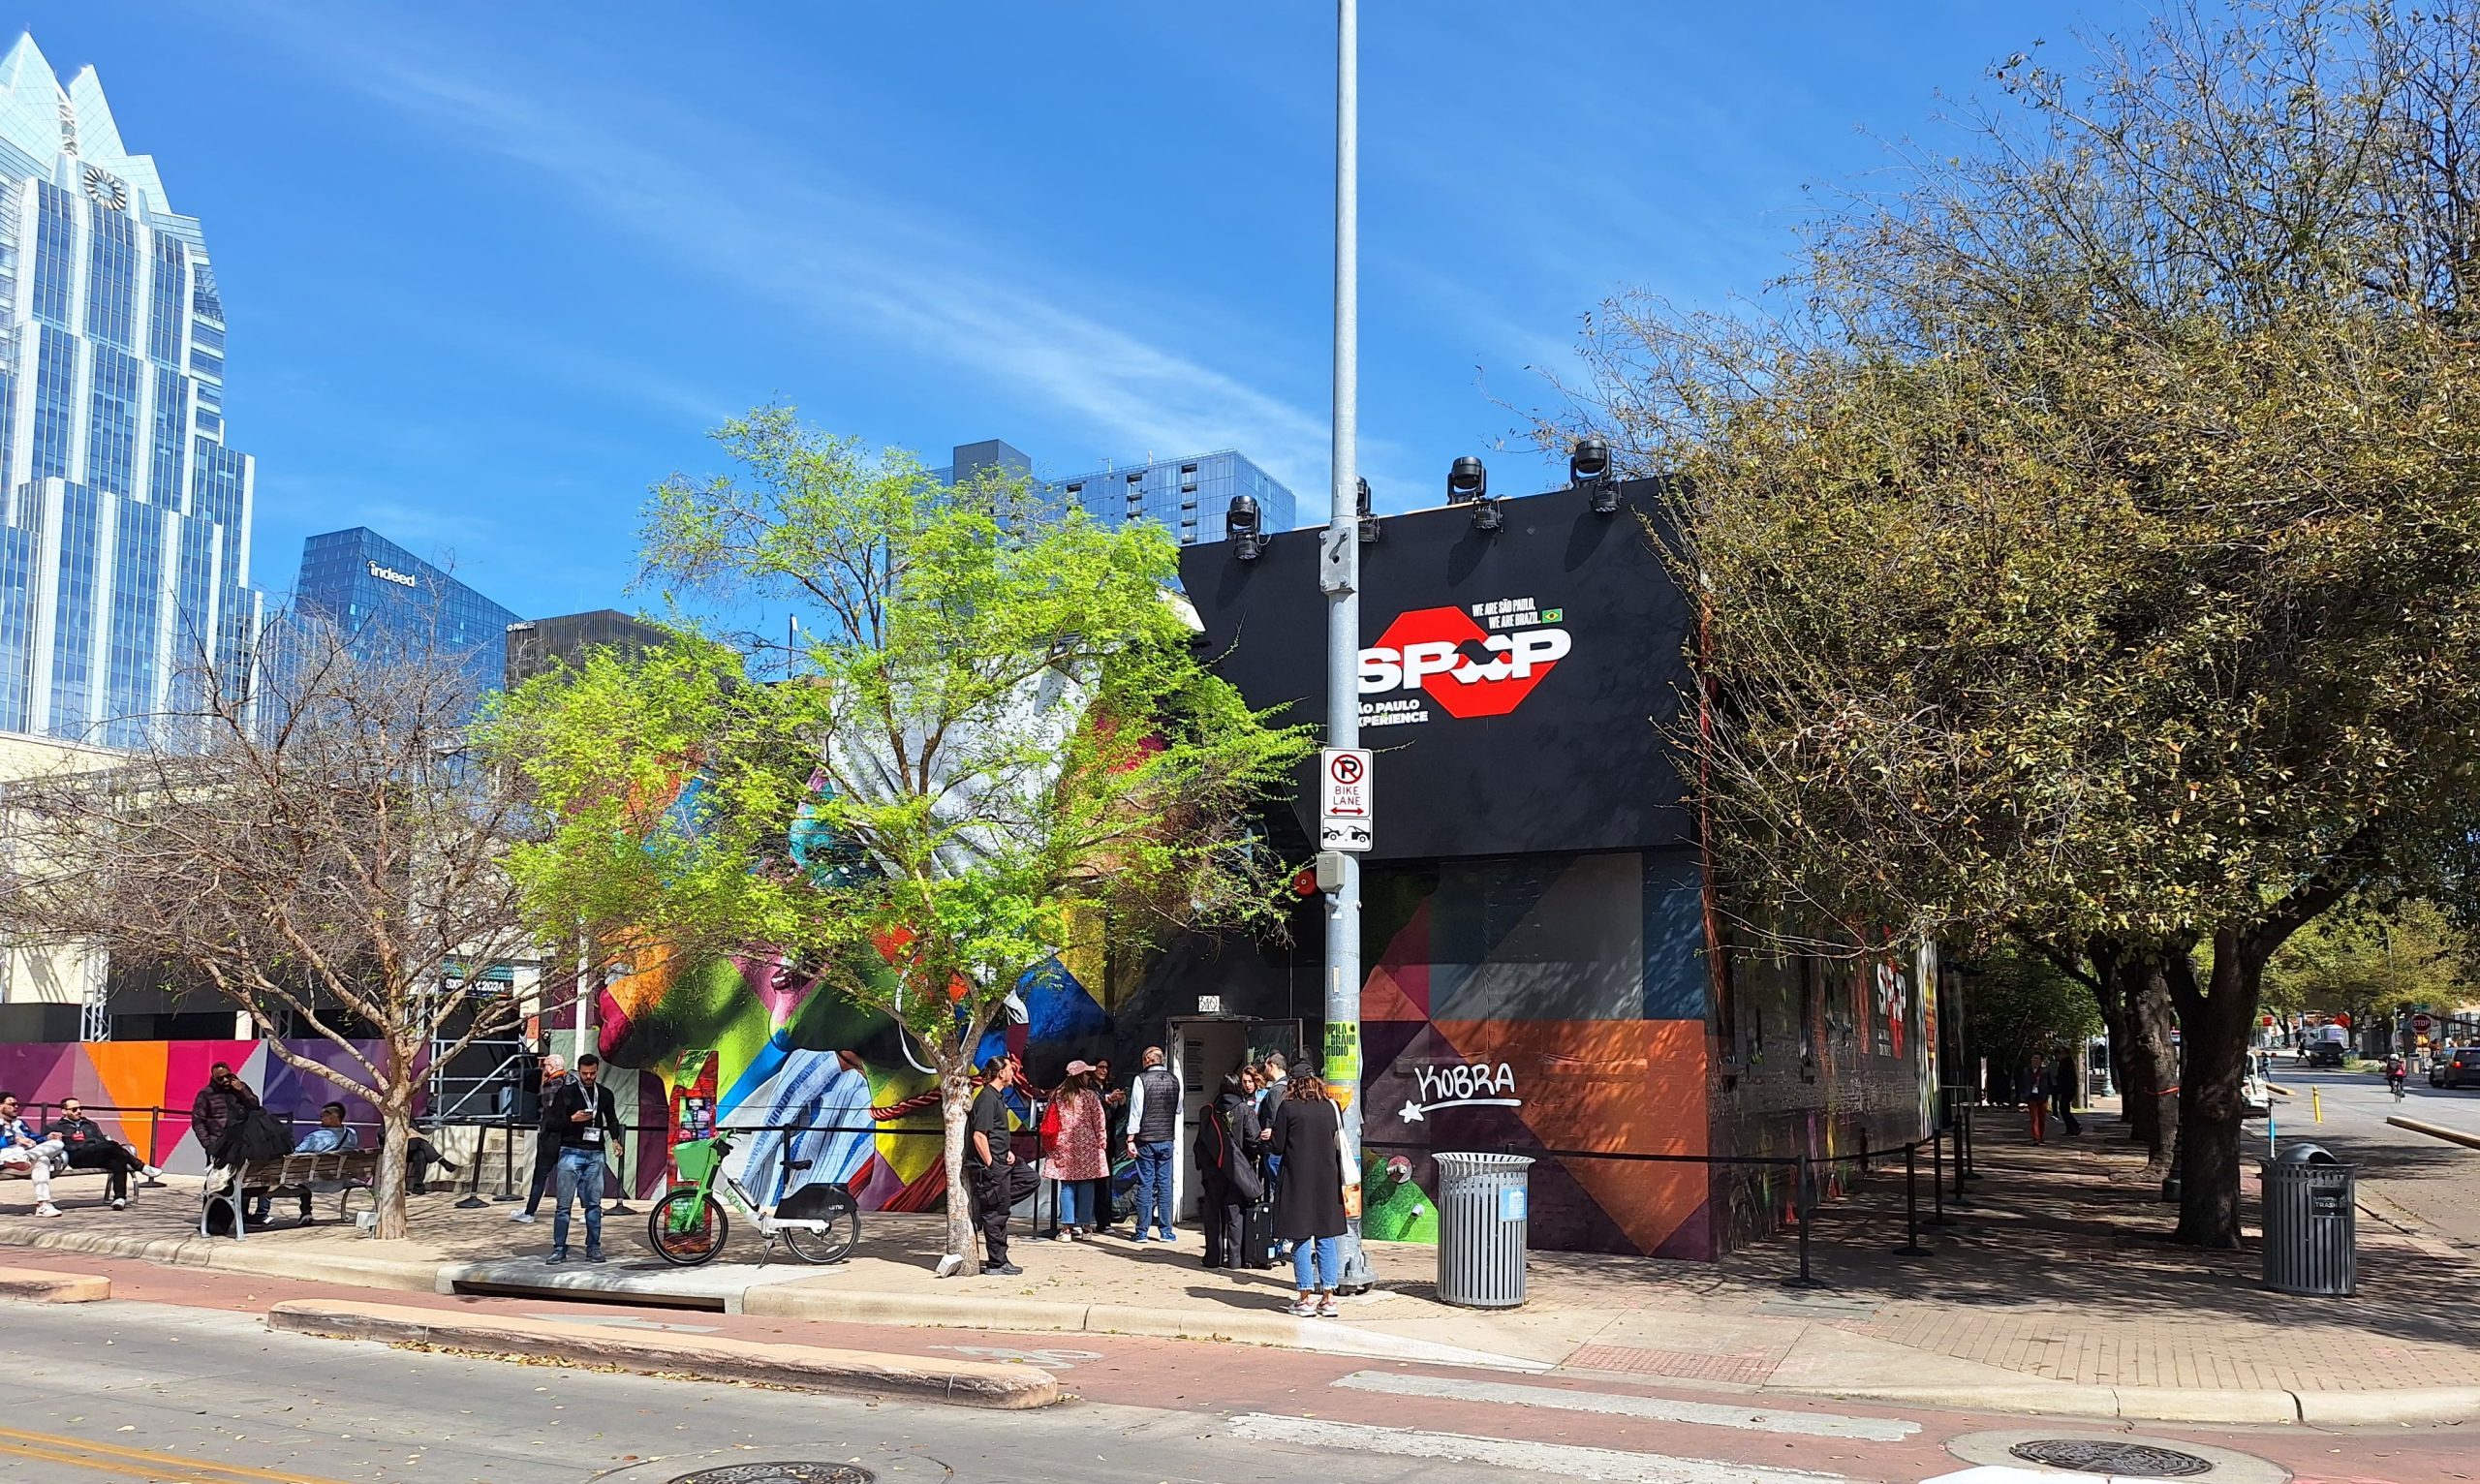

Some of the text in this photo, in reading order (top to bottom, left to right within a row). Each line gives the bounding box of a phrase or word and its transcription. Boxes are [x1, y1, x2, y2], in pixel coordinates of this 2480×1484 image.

[368, 561, 415, 587] indeed
[1472, 603, 1484, 617] WE
[1484, 602, 1498, 616] ARE
[1499, 598, 1511, 614] SÃO
[1488, 615, 1501, 630] WE
[1501, 614, 1514, 628] ARE
[1376, 698, 1420, 714] PAULO
[1335, 786, 1359, 795] BIKE
[1333, 796, 1361, 806] LANE
[2413, 1019, 2430, 1028] STOP
[1413, 1063, 1516, 1101] KOBRA
